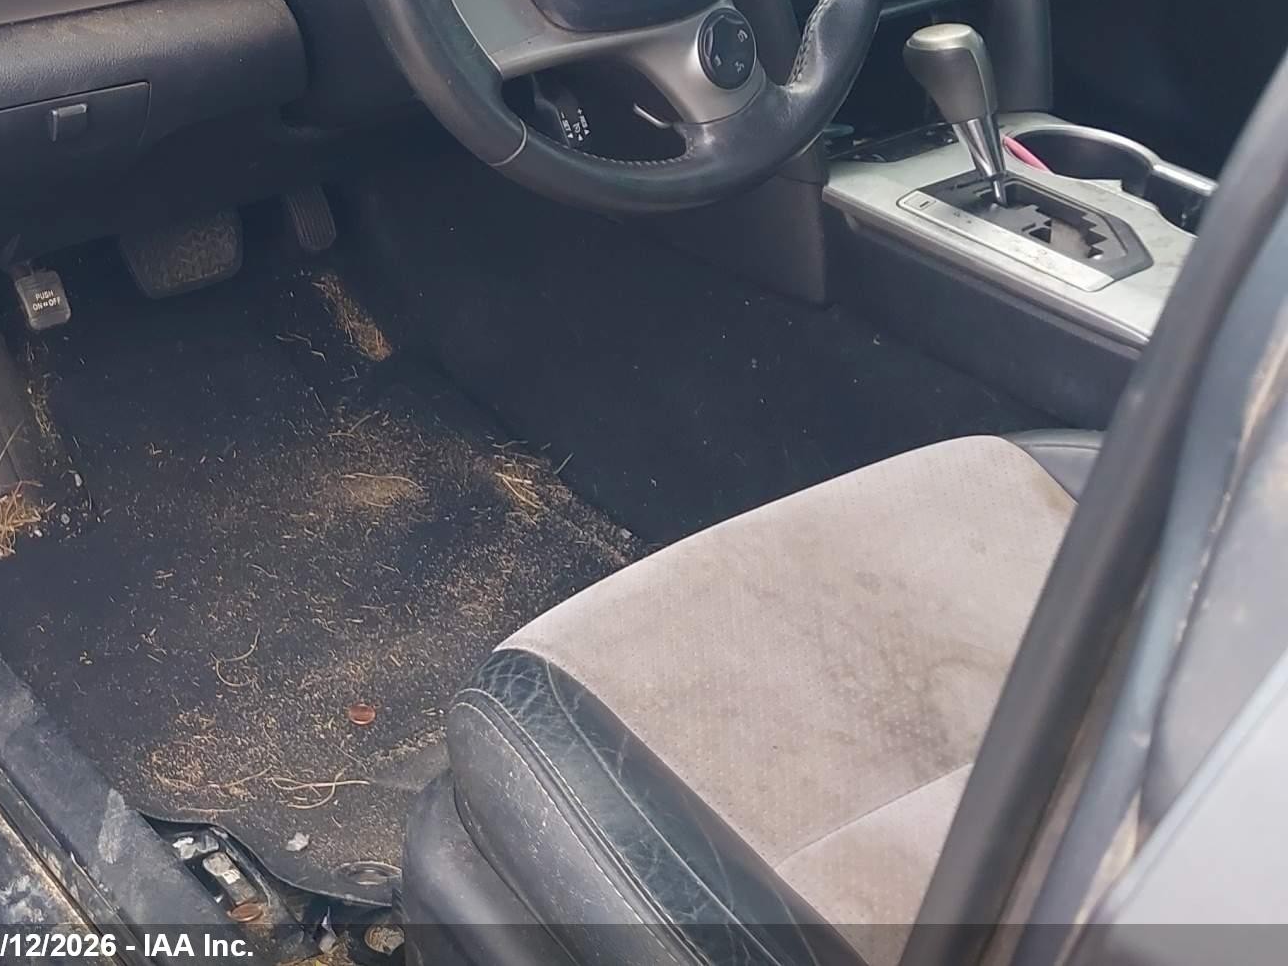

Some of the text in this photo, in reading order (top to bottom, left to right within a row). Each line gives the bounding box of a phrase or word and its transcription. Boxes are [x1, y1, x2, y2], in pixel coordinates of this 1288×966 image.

[35, 290, 54, 301] PUSH
[33, 296, 61, 311] ON OFF
